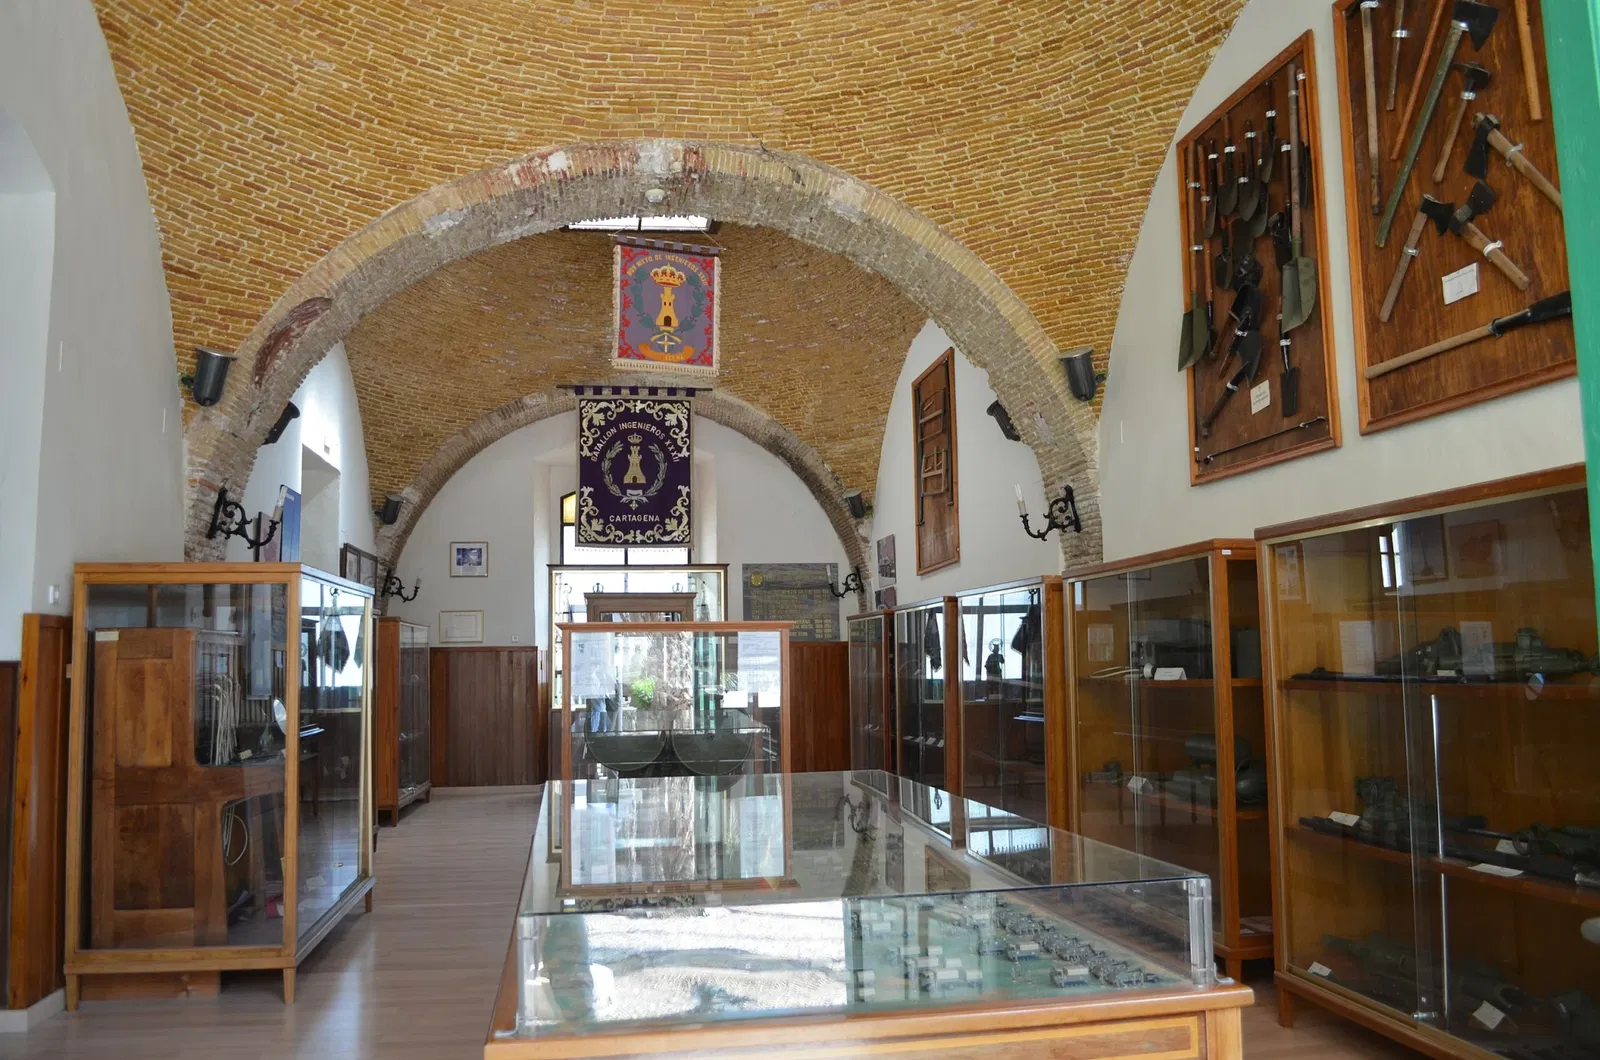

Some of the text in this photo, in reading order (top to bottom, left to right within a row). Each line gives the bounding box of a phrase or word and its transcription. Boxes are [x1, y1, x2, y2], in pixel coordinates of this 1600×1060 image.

[665, 254, 699, 272] INGENIEROS
[591, 421, 680, 462] BATALLON INGENIEROS XXXII
[609, 514, 660, 522] CARTAGENA
